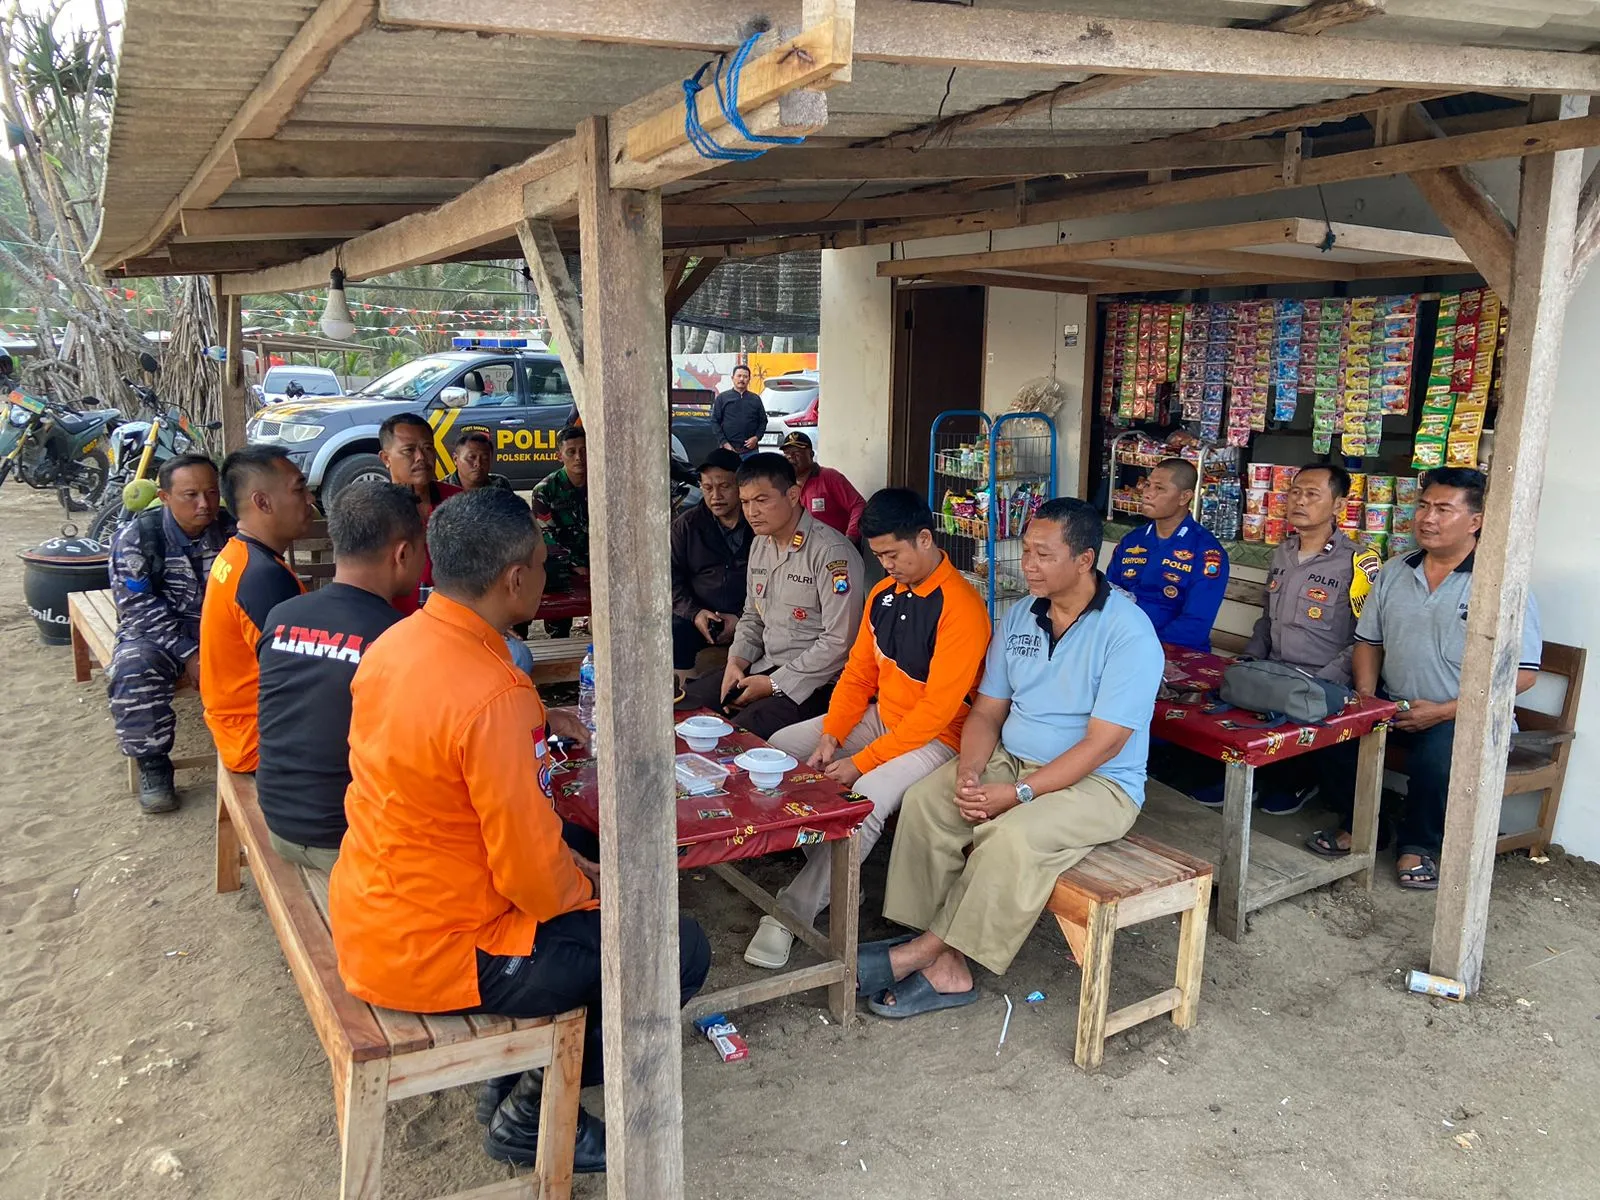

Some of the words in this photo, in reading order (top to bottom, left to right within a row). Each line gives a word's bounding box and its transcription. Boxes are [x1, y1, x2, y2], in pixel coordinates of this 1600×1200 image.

[496, 429, 559, 450] POLI
[496, 452, 532, 462] POLSEK
[1121, 557, 1147, 565] CAHYONO
[1161, 558, 1192, 573] POLRI
[786, 573, 813, 585] POLRI
[1308, 573, 1339, 589] POLRI
[271, 624, 373, 664] LINMA
